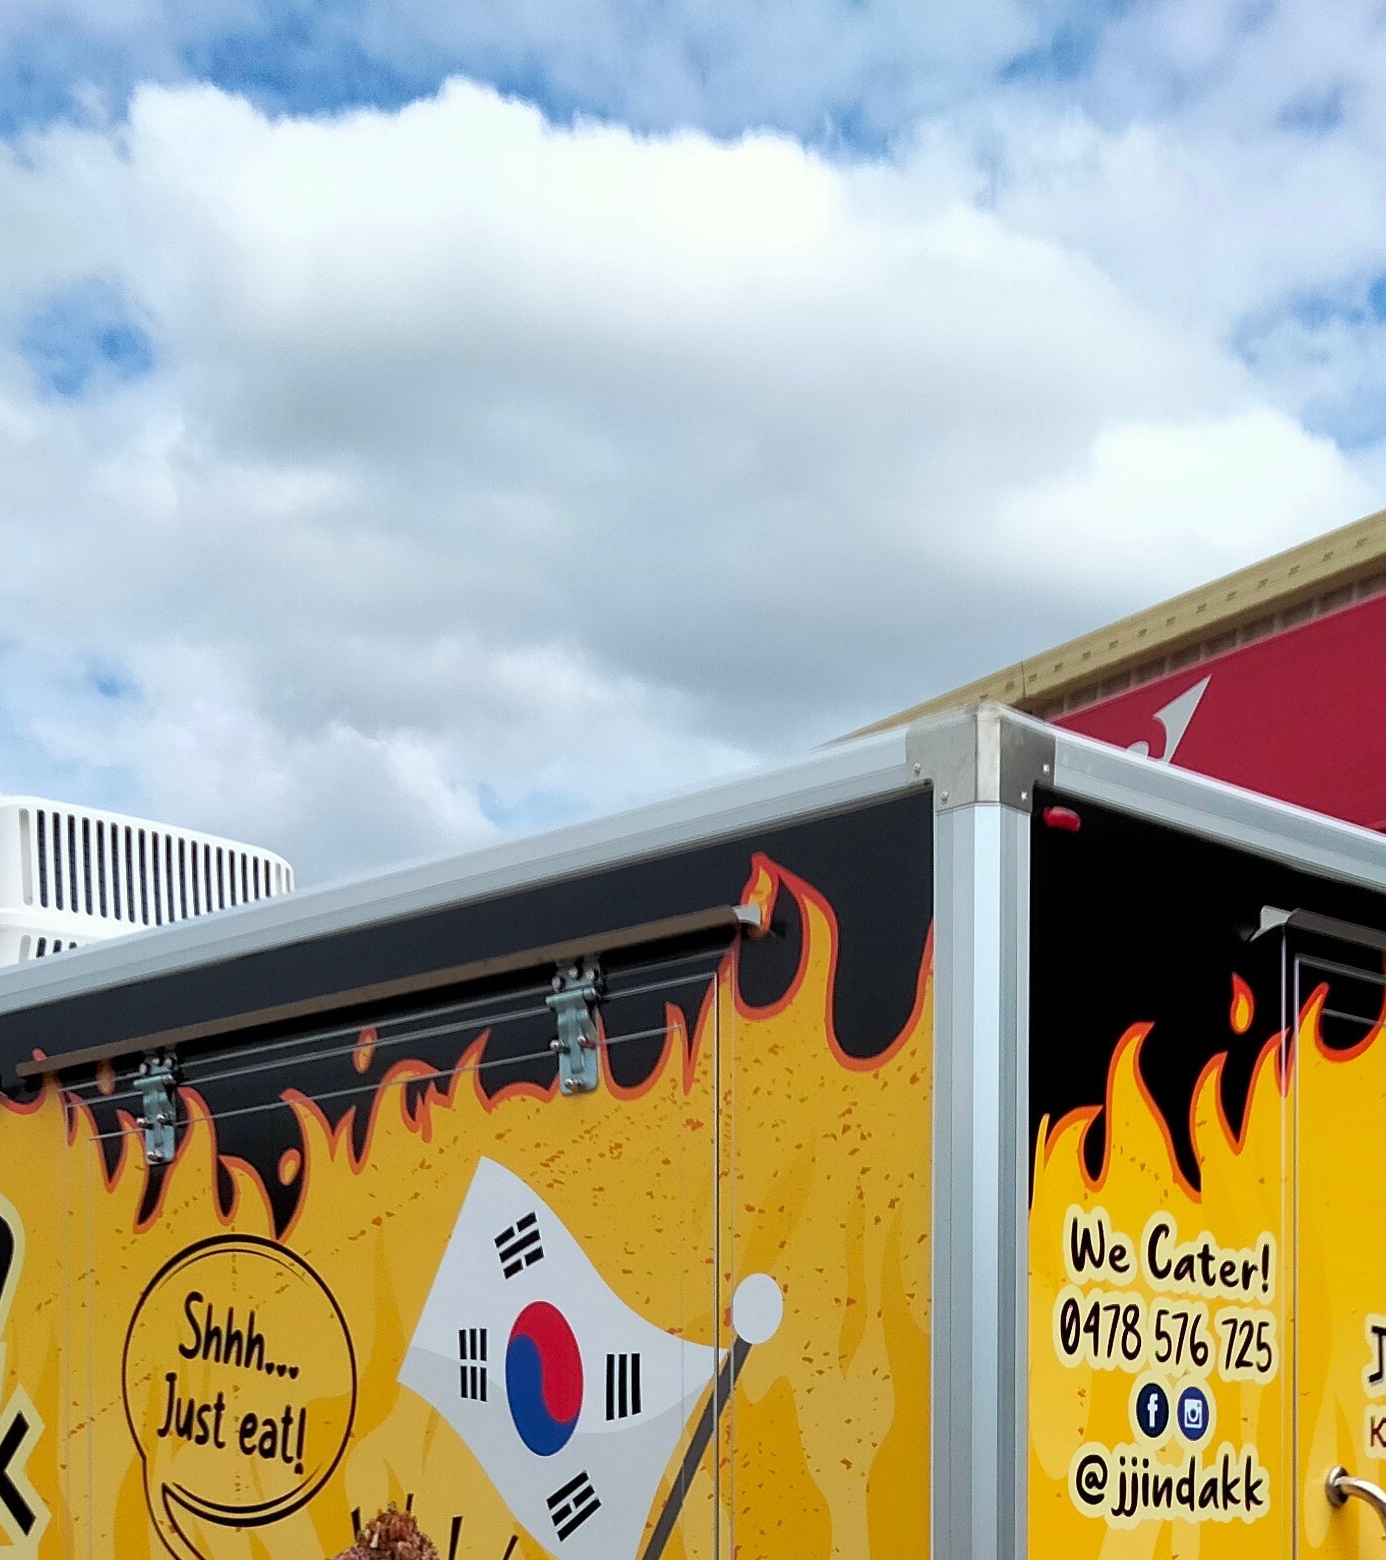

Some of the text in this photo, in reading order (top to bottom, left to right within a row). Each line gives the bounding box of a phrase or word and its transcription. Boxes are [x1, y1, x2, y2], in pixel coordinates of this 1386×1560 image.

[1069, 1217, 1270, 1293] We Cater!
[178, 1291, 300, 1379] Shhh...
[1060, 1297, 1272, 1373] 0478 576 725
[157, 1372, 306, 1475] Just eat!
[1075, 1454, 1264, 1517] @jjindakk
